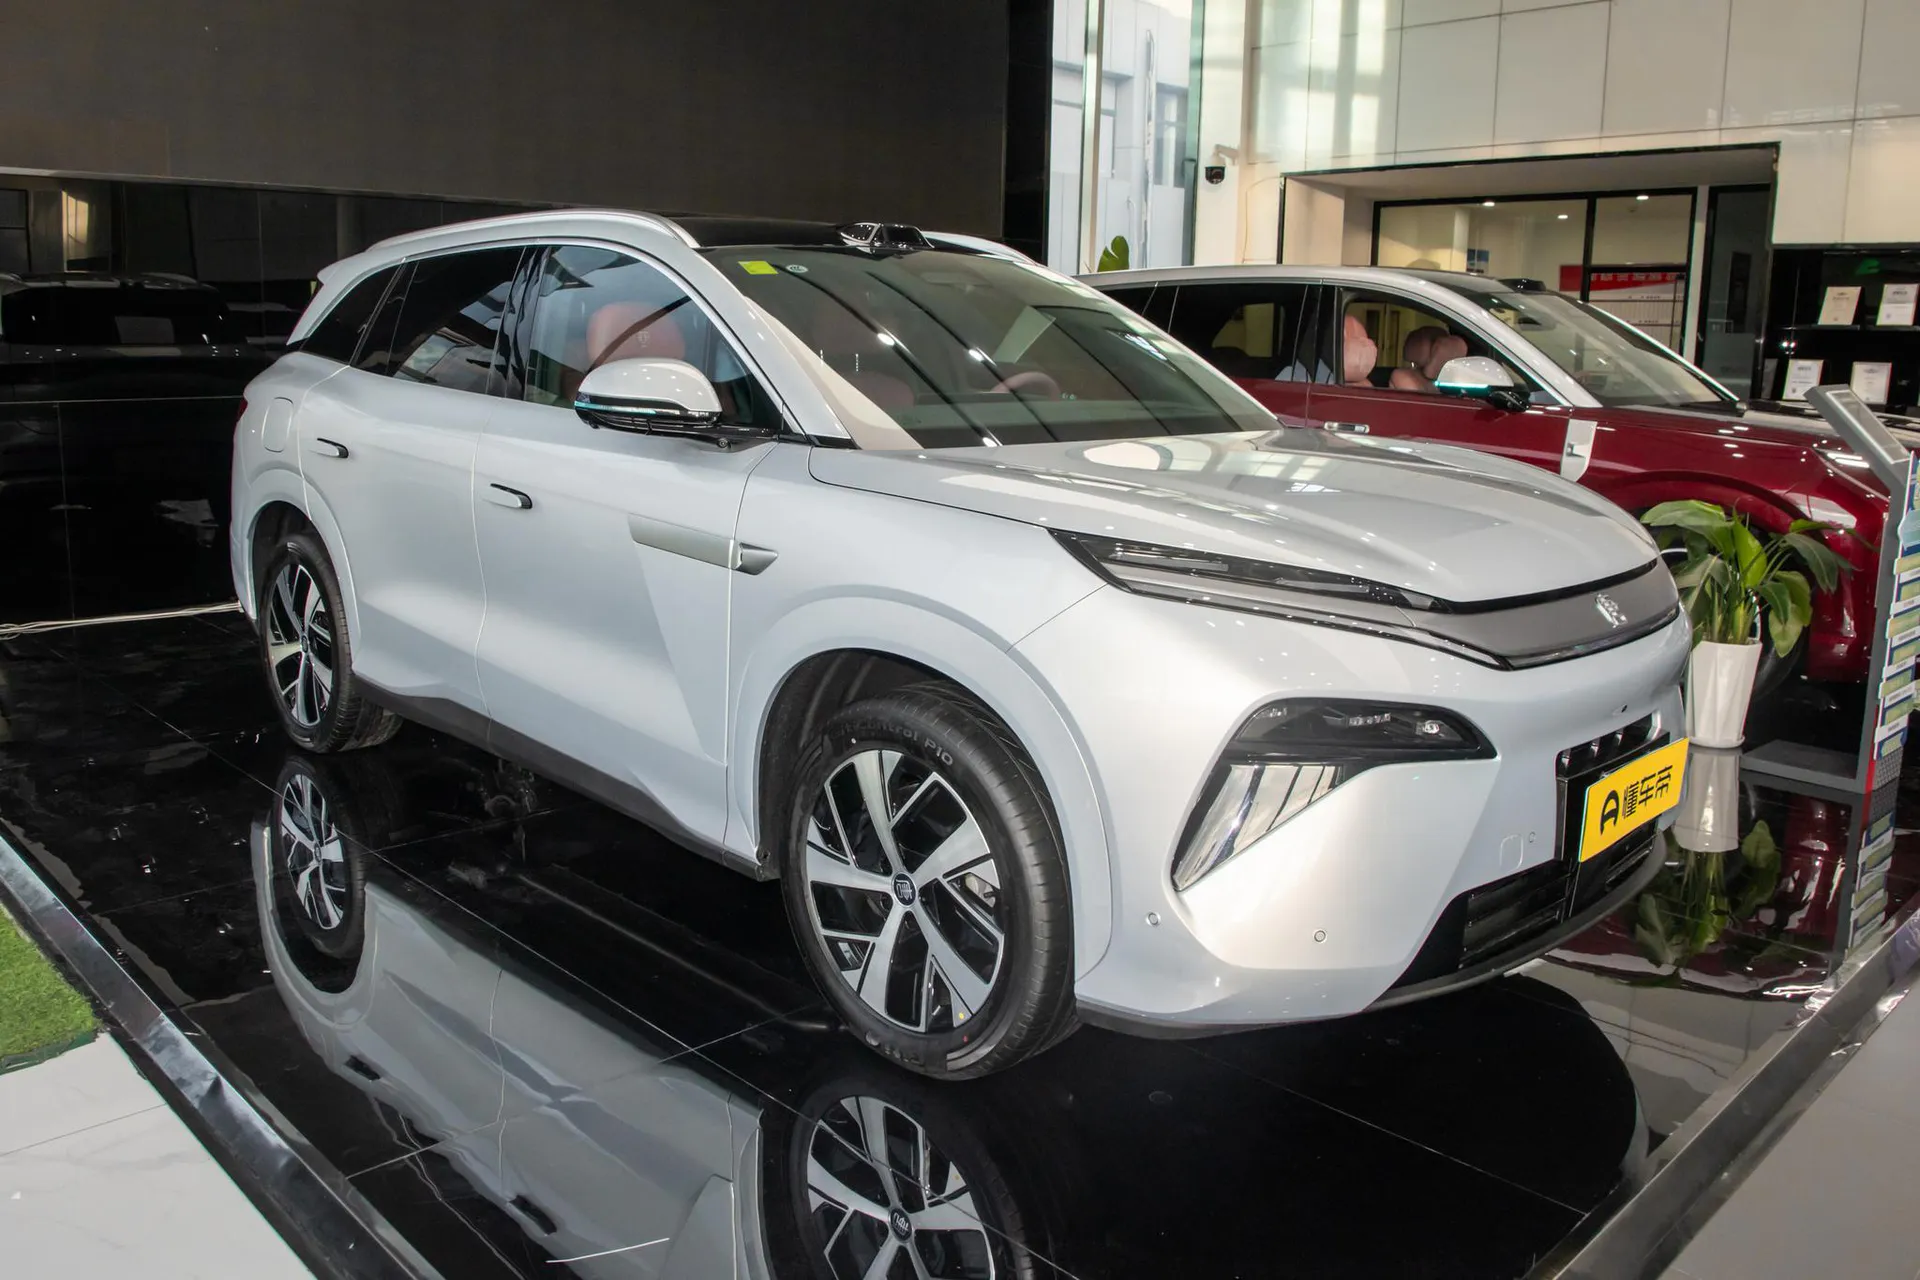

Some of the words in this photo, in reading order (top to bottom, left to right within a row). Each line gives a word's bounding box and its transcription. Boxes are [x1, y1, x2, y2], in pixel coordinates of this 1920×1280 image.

[923, 737, 954, 767] P10
[1622, 764, 1673, 819] 懂车帝
